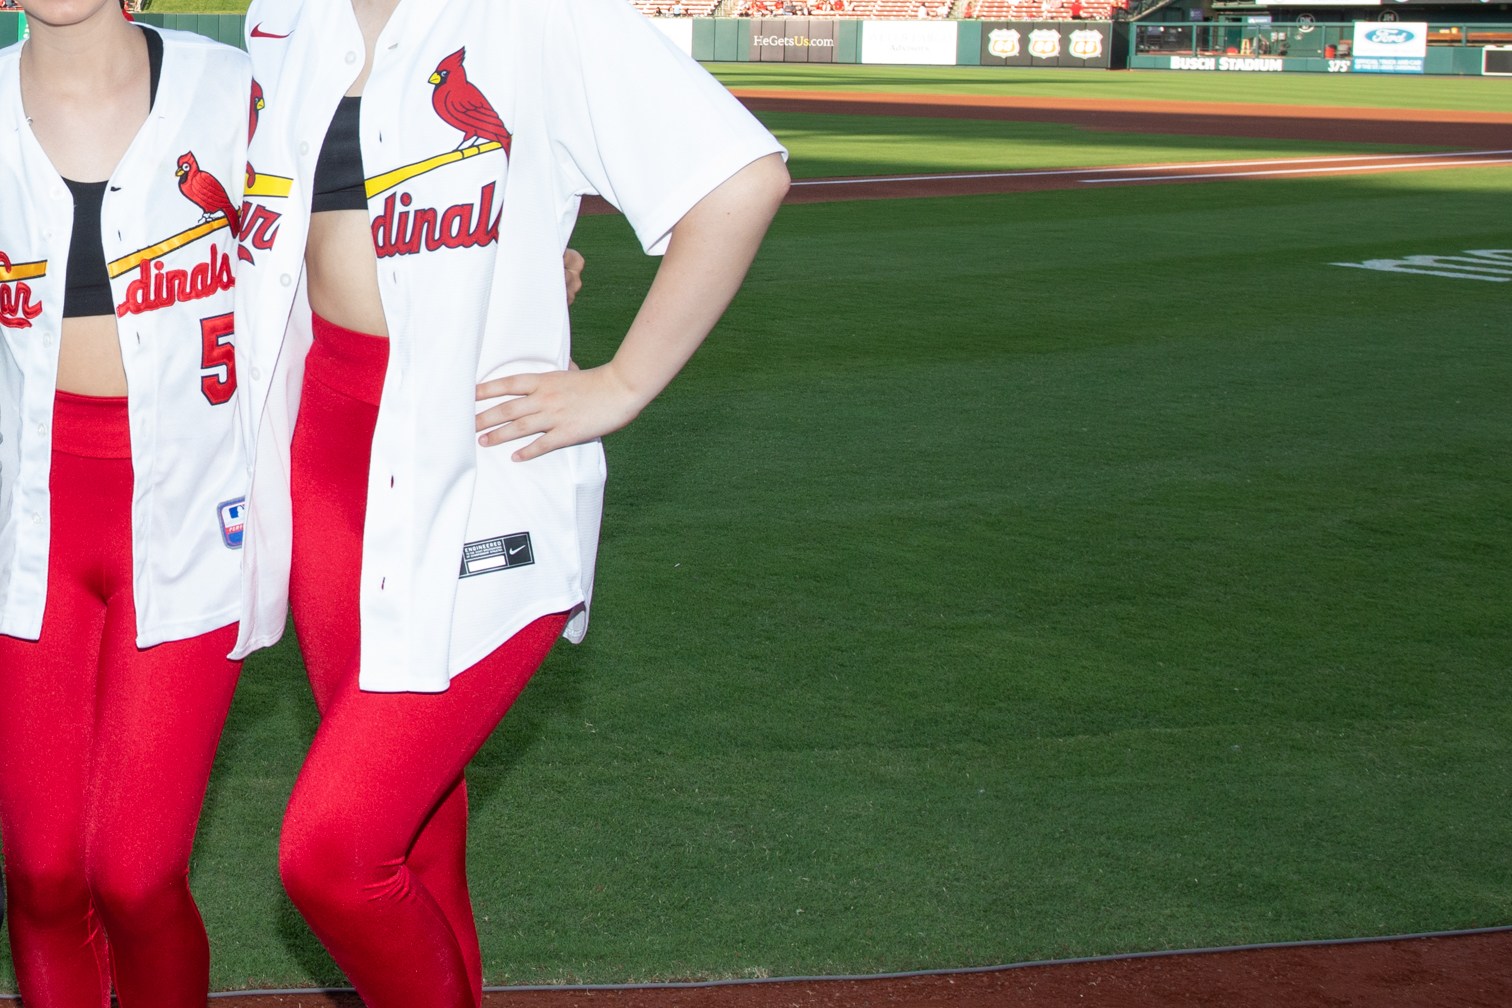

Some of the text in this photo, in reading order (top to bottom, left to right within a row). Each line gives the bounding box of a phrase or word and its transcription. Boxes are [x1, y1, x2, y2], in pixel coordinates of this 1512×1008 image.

[753, 35, 834, 47] HeGetsUs.com
[1371, 28, 1407, 43] Ford
[1170, 56, 1283, 71] BUSCH STADIUM
[116, 242, 235, 318] dinals
[464, 541, 502, 552] ENGINEERED
